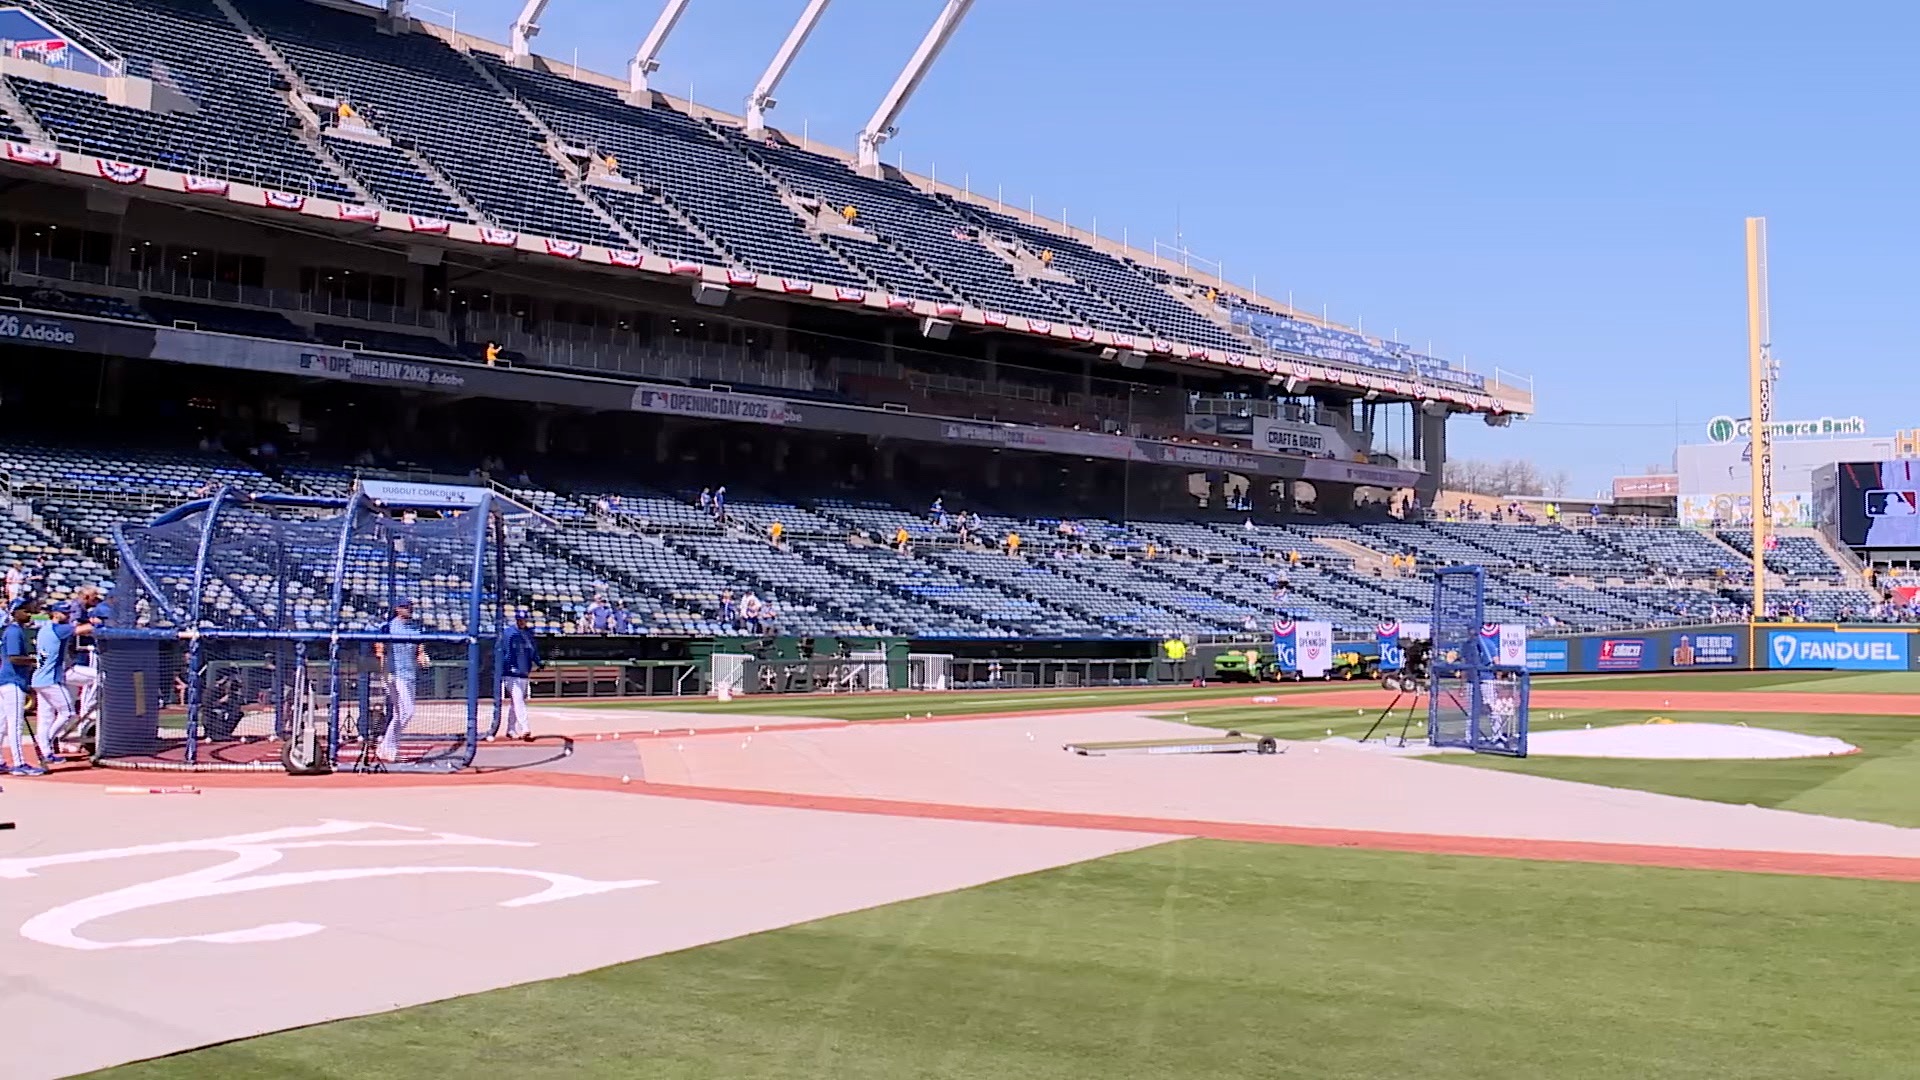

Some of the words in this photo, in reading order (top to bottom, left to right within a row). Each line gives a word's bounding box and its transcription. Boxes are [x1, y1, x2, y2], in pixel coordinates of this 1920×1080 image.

[21, 324, 75, 343] Adobe
[329, 355, 379, 377] OPENING
[380, 363, 401, 380] DAY
[402, 365, 430, 383] 2026
[430, 372, 465, 386] Adobe
[670, 393, 717, 415] OPENING
[719, 399, 742, 417] DAY
[742, 401, 769, 419] 2026
[769, 408, 802, 423] Adobe
[1822, 418, 1861, 433] Bank
[1268, 431, 1291, 445] CRAFT
[1292, 434, 1298, 446] &
[1300, 435, 1321, 449] DRAFT
[382, 486, 416, 496] DUGOUT
[418, 488, 465, 499] CONCOURSE
[1276, 643, 1296, 666] KC
[1380, 643, 1399, 664] KC
[1800, 641, 1900, 661] FANDUEL
